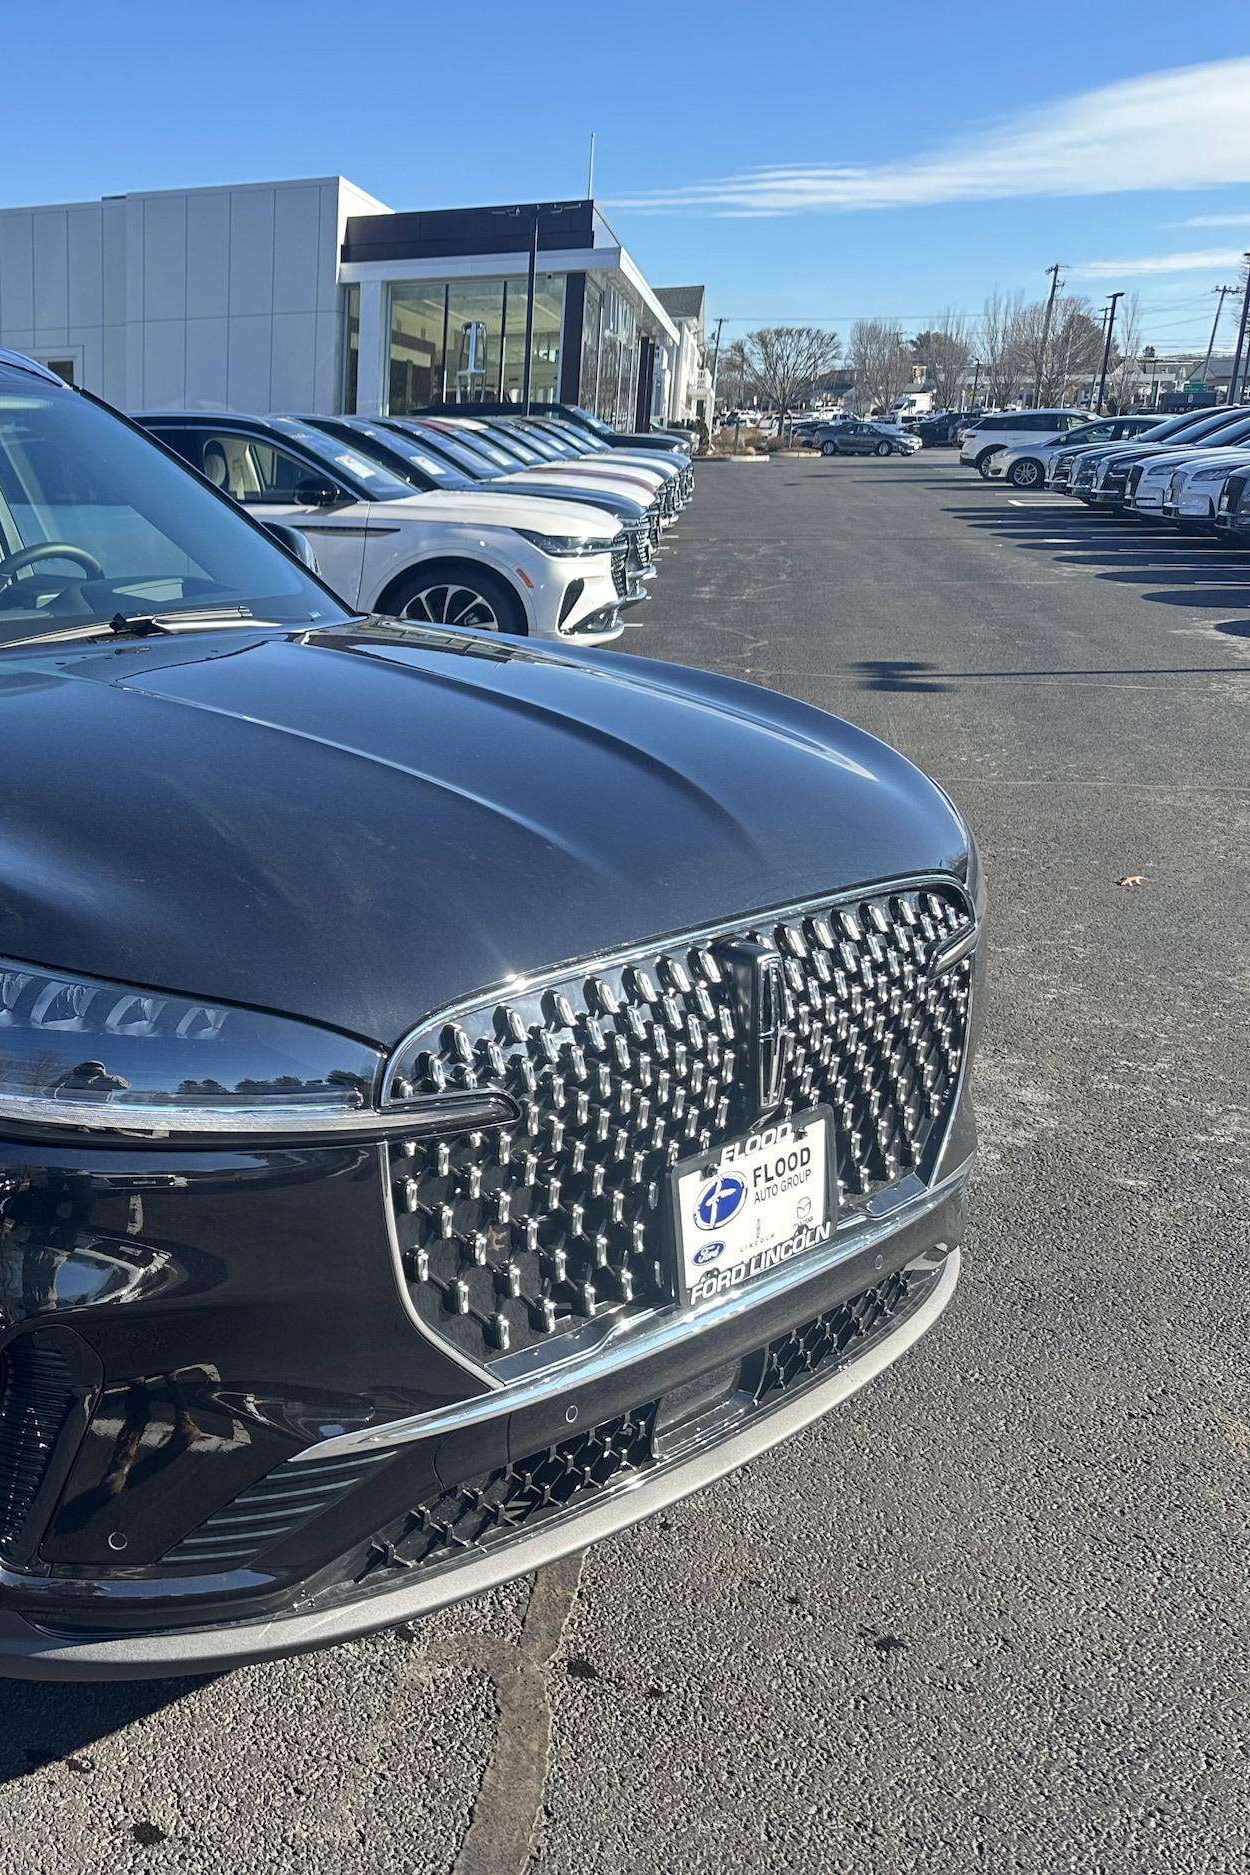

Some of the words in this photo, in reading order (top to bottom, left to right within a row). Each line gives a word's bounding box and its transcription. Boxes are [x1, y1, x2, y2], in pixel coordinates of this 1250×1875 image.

[721, 1122, 793, 1163] FLOOD
[753, 1147, 811, 1187] FLOOD
[754, 1184, 778, 1205] AUTO
[781, 1169, 812, 1196] GROUP
[696, 1243, 723, 1264] Ford
[740, 1232, 775, 1253] LINCOLN
[691, 1265, 746, 1305] FORD
[750, 1222, 831, 1274] LINCOLN
